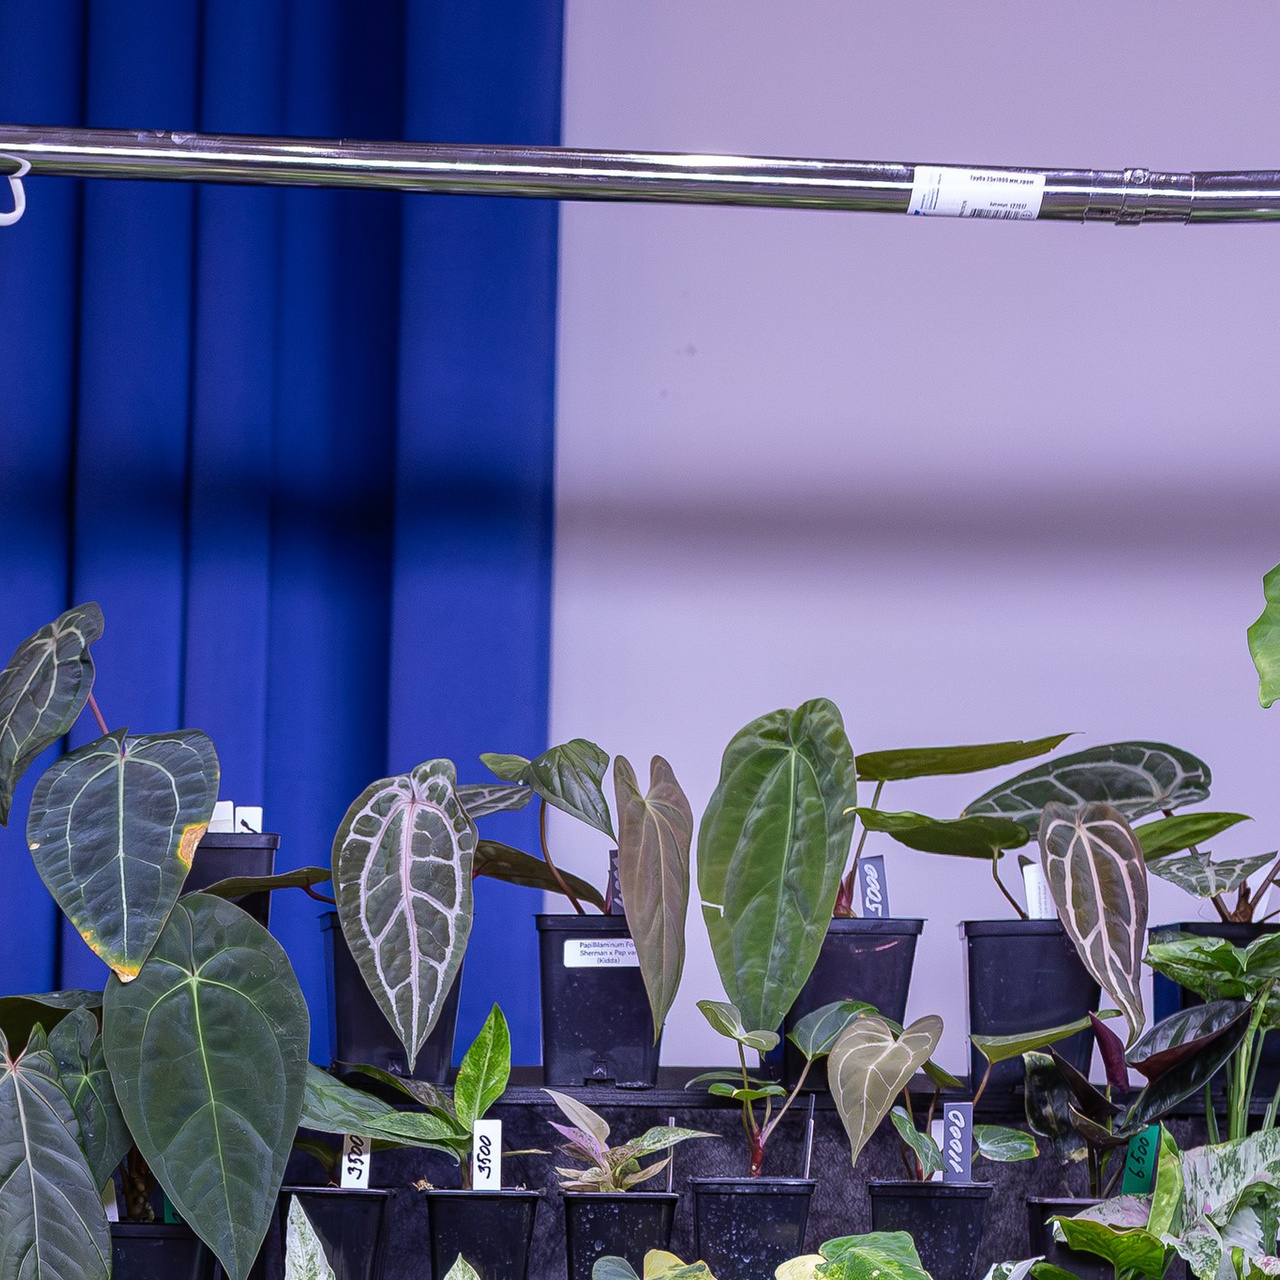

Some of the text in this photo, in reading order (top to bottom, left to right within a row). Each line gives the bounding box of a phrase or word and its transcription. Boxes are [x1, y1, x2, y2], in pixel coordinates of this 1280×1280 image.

[863, 863, 883, 918] 5000
[346, 1134, 365, 1181] 3500
[476, 1134, 492, 1180] 3500
